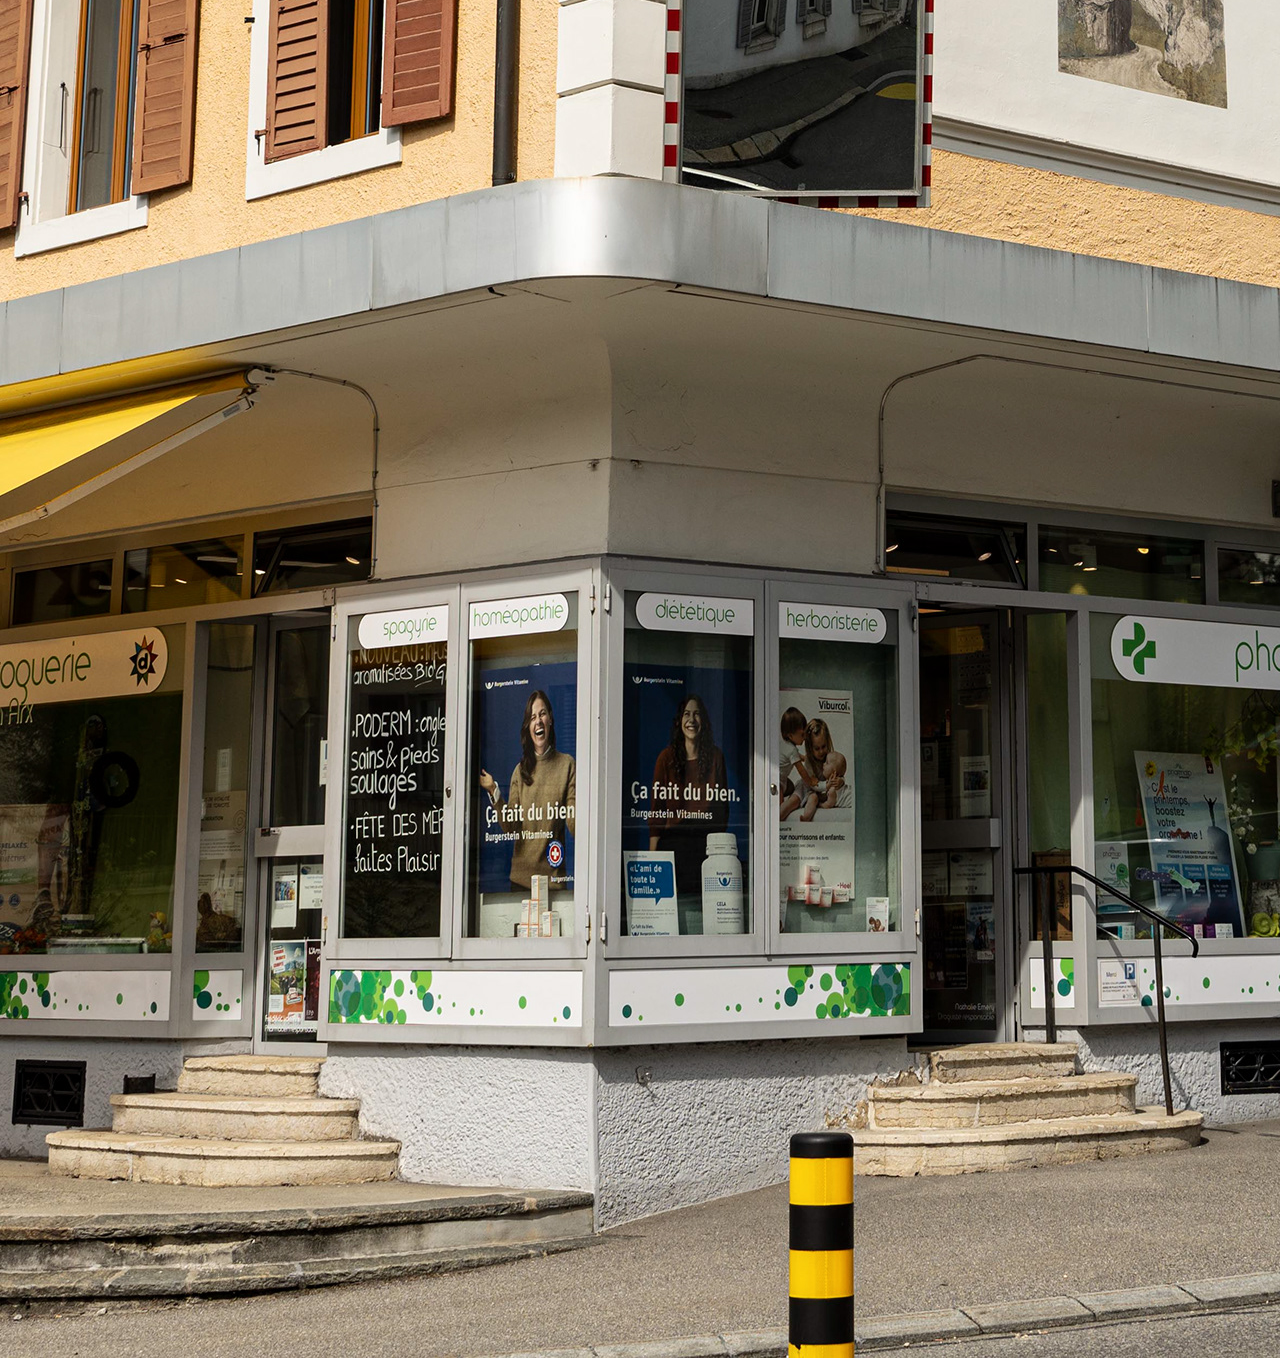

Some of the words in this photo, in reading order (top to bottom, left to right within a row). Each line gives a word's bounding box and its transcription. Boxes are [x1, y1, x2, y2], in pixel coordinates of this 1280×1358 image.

[473, 599, 564, 629] homéopathie
[655, 598, 736, 628] diététique
[786, 607, 878, 632] herboristerie
[383, 612, 437, 641] spagyrie
[354, 663, 413, 685] aromatisées
[8, 697, 34, 725] Arx
[350, 746, 385, 771] sains
[350, 765, 418, 810] soulagés
[630, 781, 648, 804] Ça
[652, 781, 680, 800] fait
[683, 782, 701, 801] du
[705, 783, 741, 802] bien.
[485, 804, 498, 828] Ça
[501, 802, 525, 823] fait
[527, 802, 543, 822] du
[546, 800, 576, 820] bien
[630, 808, 674, 821] Burgerstein
[676, 809, 713, 820] Vitamines
[1155, 805, 1186, 816] boostez
[355, 810, 386, 840] FÊTE
[393, 812, 418, 836] DES
[1157, 819, 1177, 828] votre
[485, 830, 520, 844] Burgerstein
[521, 828, 554, 840] Vitamines
[788, 833, 818, 841] nourrissons
[354, 843, 393, 873] faites
[397, 846, 441, 873] Plaisir
[653, 864, 663, 873] de
[629, 875, 649, 883] toute
[649, 875, 656, 883] la
[1126, 963, 1135, 979] P
